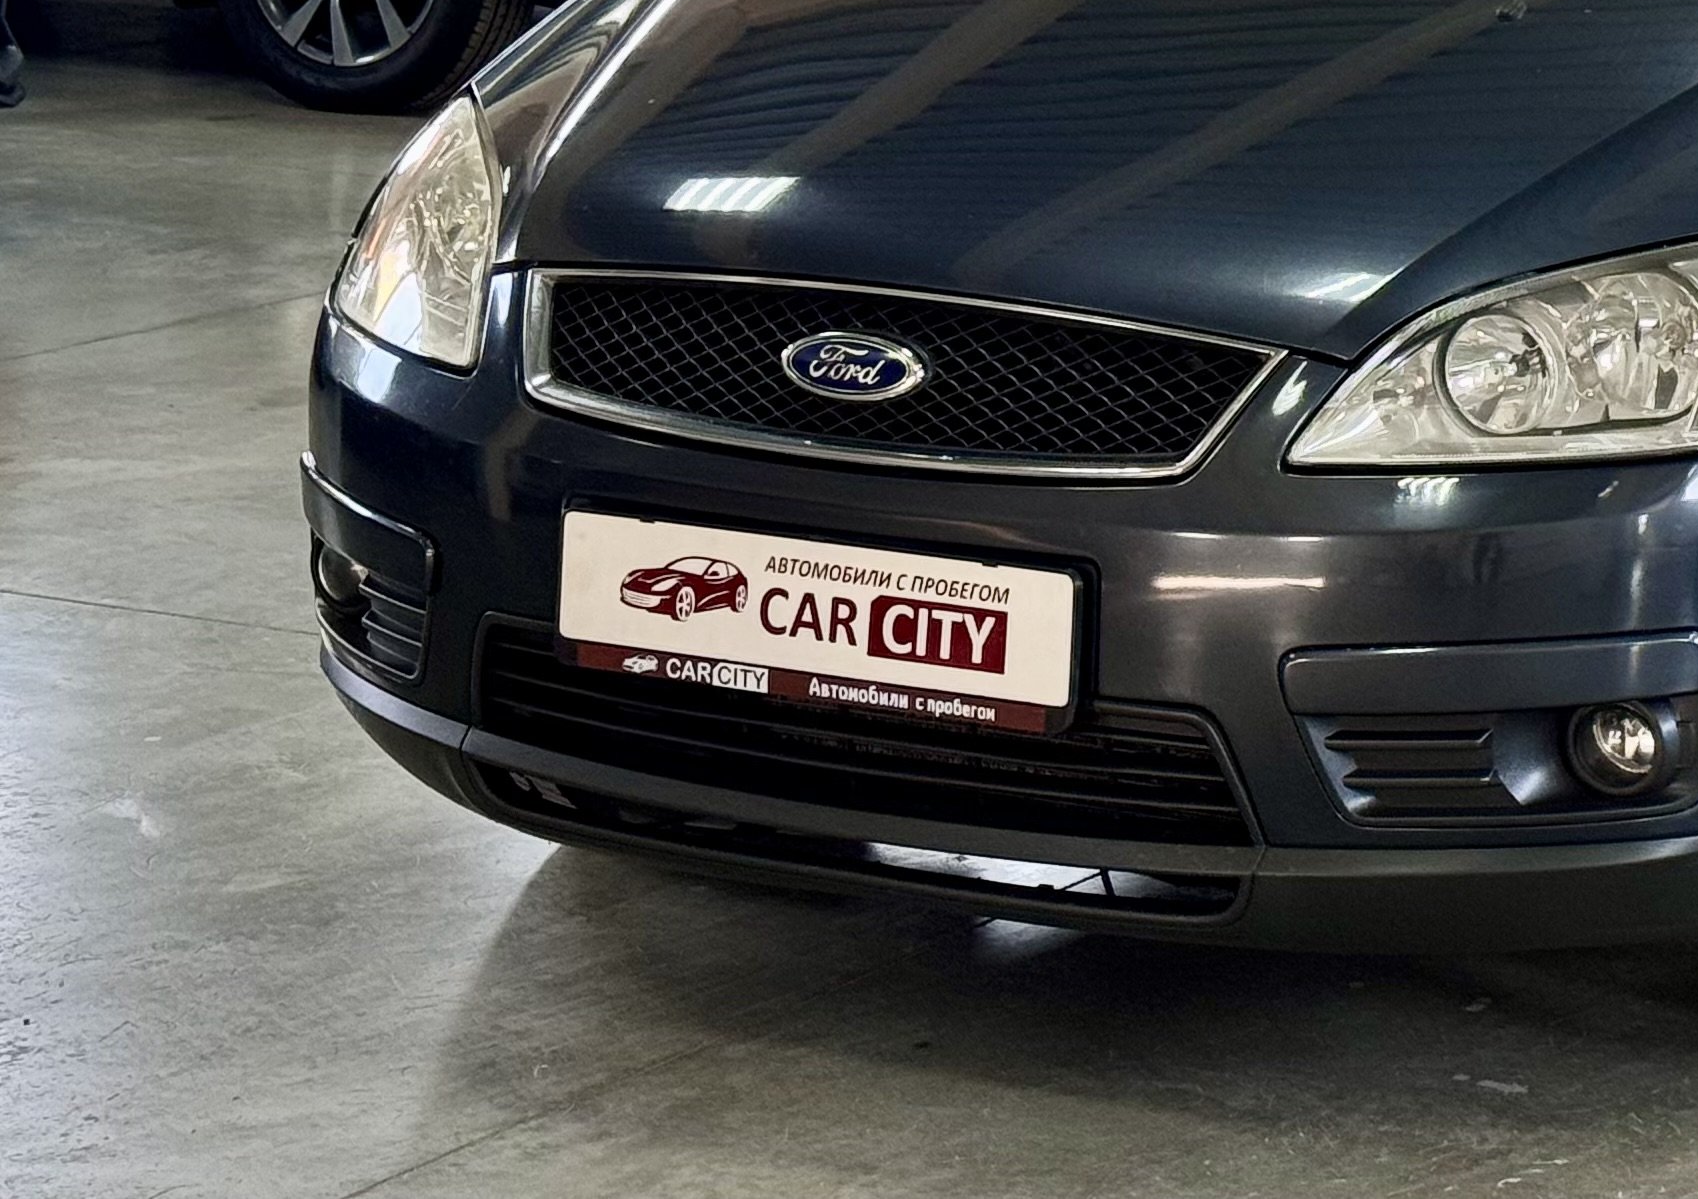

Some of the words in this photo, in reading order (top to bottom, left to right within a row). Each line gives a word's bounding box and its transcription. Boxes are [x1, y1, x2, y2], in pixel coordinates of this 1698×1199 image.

[809, 344, 886, 385] Ford
[764, 555, 892, 589] АВТОМОБИЛИ
[896, 574, 907, 591] С
[911, 576, 1010, 604] ПРОБЕГОМ
[759, 587, 858, 646] CAR
[881, 604, 996, 664] CITY
[808, 676, 909, 710] Автомобили
[915, 698, 924, 710] с
[926, 698, 996, 721] пробегом
